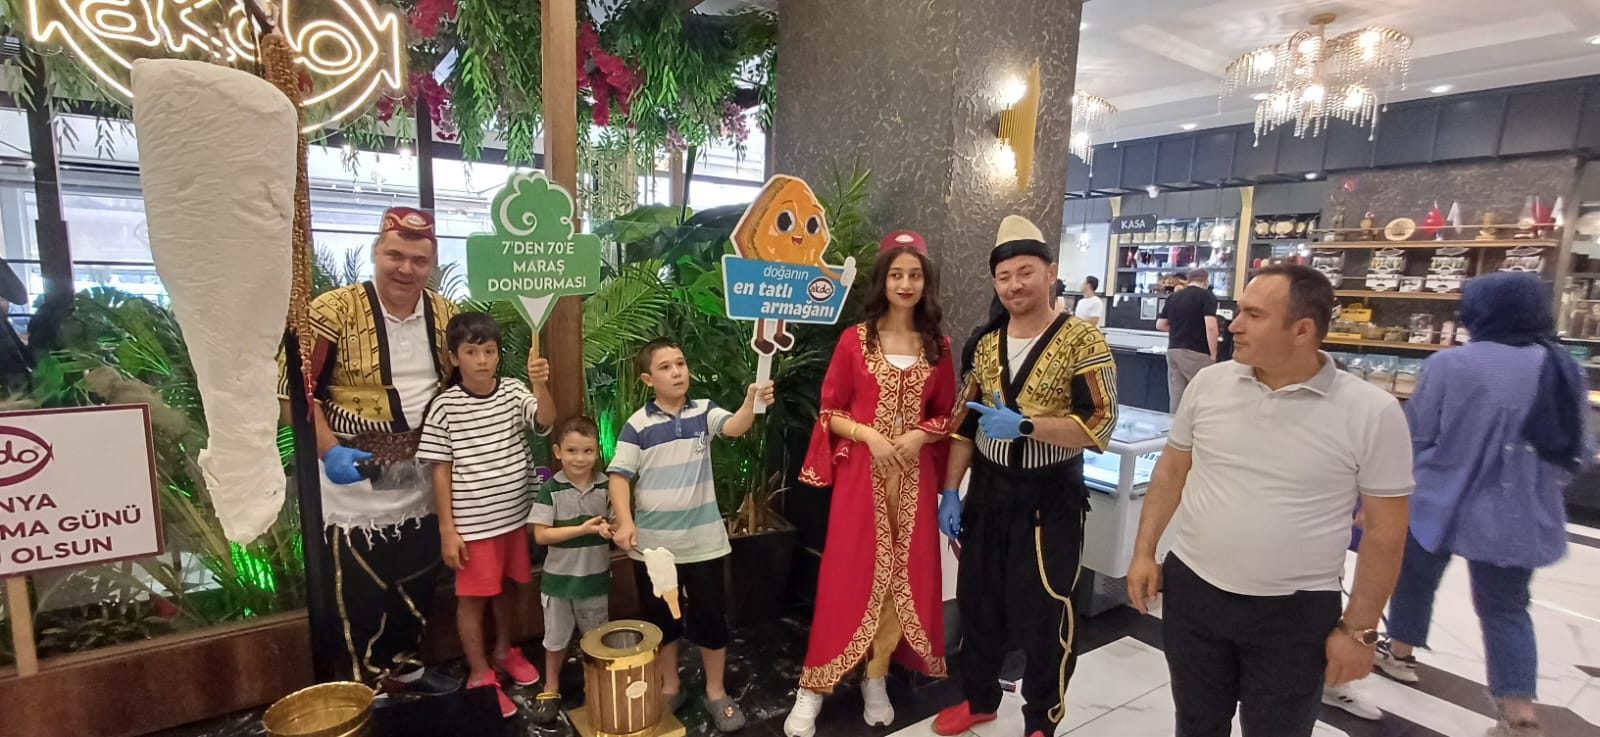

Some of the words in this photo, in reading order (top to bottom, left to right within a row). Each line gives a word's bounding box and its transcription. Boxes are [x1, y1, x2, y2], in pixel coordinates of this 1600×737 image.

[1121, 219, 1146, 229] KASA
[502, 240, 544, 255] 7'DEN
[547, 241, 575, 255] 70'E
[513, 260, 565, 275] MARAŞ
[763, 265, 809, 280] doğanın
[488, 277, 586, 291] DONDURMASI
[733, 282, 754, 295] en
[758, 282, 793, 298] tatlı
[810, 283, 831, 294] akdo
[761, 300, 834, 318] armağanı
[0, 519, 50, 540] MA
[58, 504, 141, 532] GÜNÜ
[11, 536, 113, 564] OLSUN
